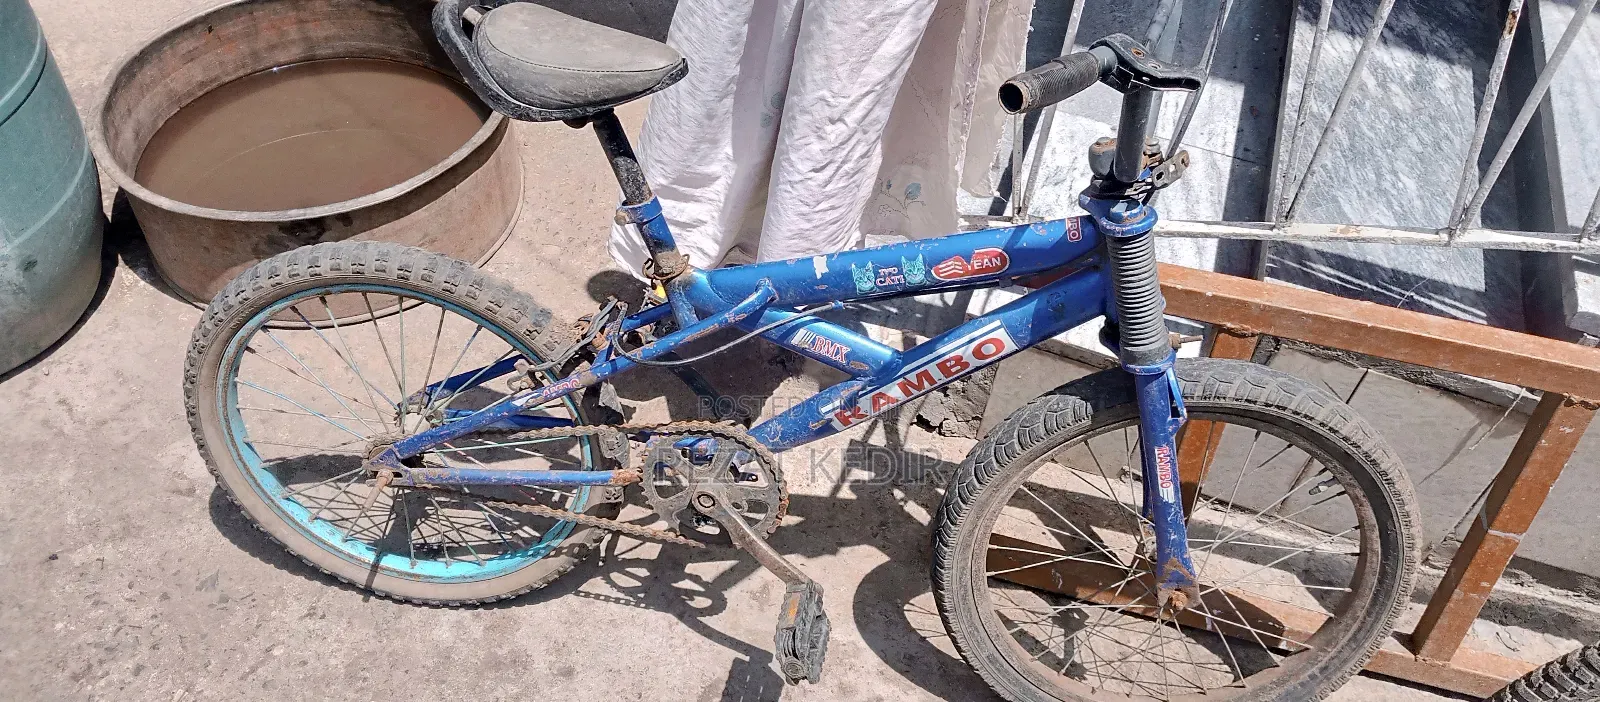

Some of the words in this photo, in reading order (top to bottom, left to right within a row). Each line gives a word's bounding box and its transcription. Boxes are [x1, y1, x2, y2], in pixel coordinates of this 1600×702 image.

[812, 336, 851, 363] BMX
[833, 338, 1006, 427] RAMBO
[1156, 445, 1172, 489] RAMBO
